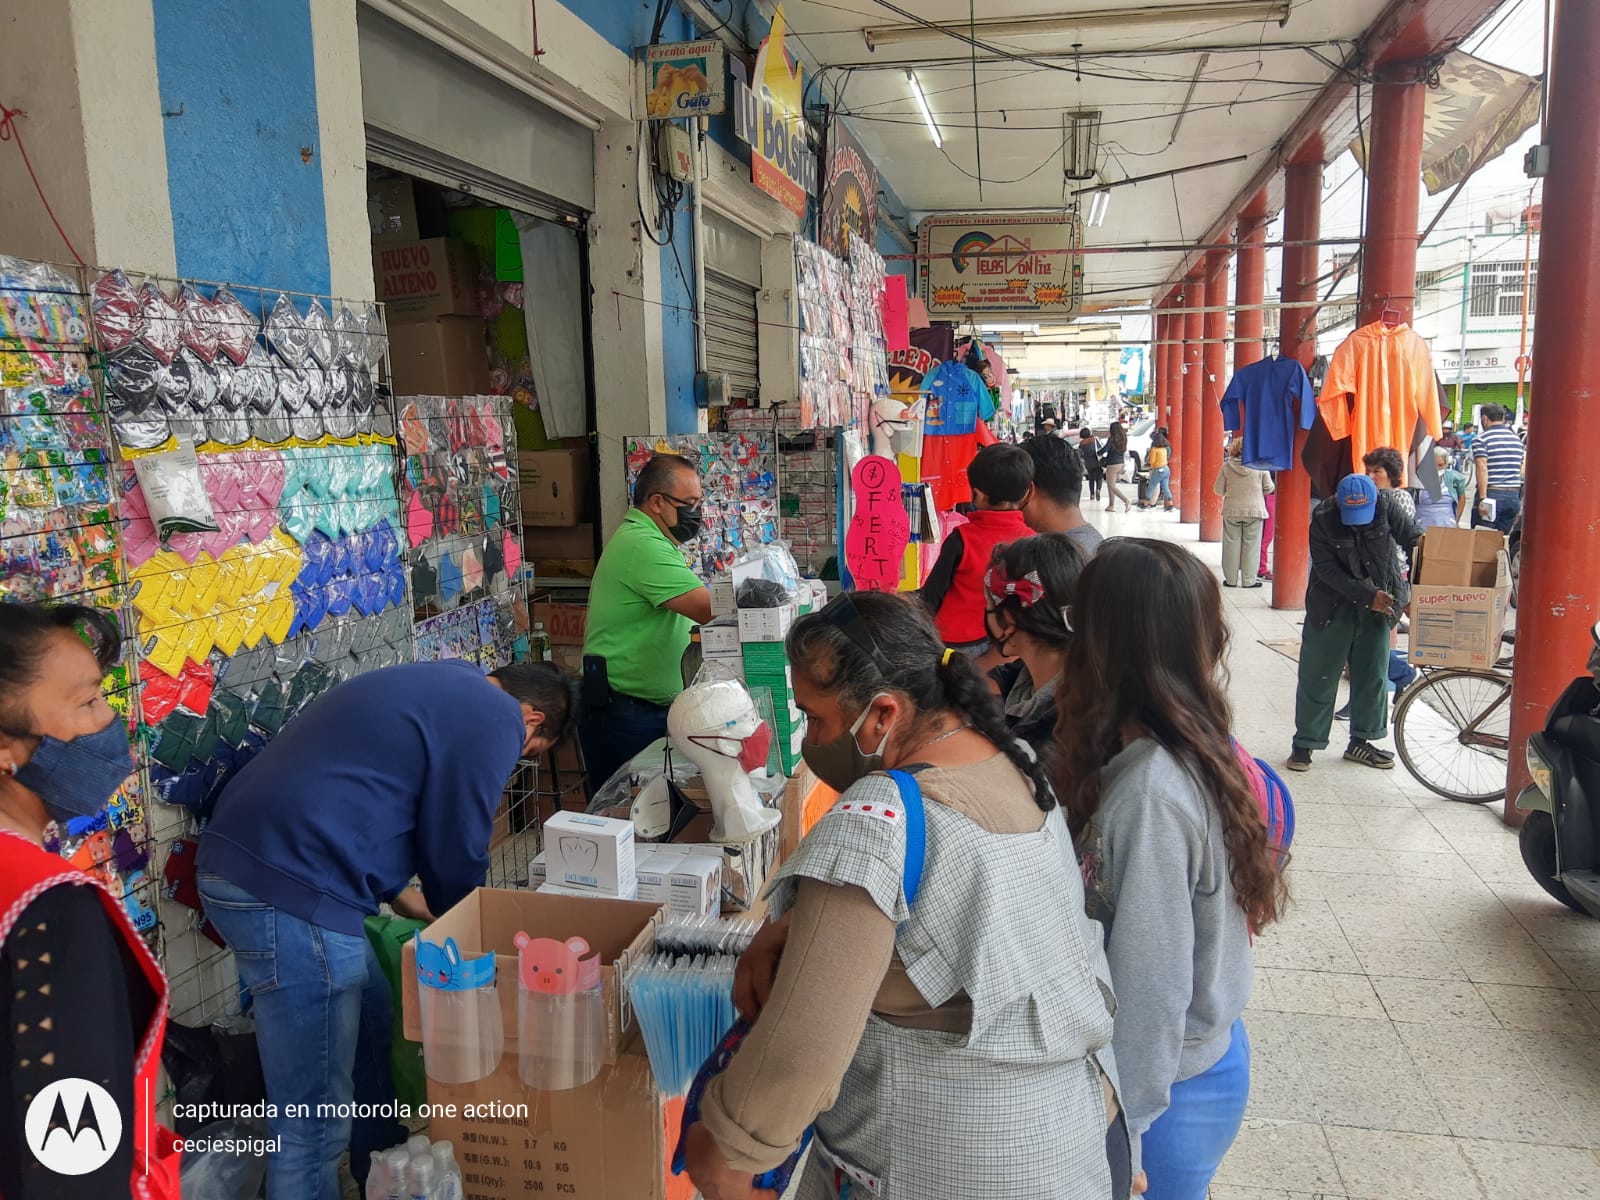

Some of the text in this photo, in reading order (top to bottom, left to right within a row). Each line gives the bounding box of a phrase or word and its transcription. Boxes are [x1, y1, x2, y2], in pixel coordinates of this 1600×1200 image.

[729, 53, 758, 150] Tu
[381, 245, 430, 272] HUEVO
[1485, 356, 1499, 367] 3B
[1418, 594, 1449, 606] super
[1452, 592, 1488, 603] huevo
[133, 911, 153, 927] N95
[553, 1141, 568, 1152] KG
[556, 1162, 569, 1173] KG
[556, 1183, 576, 1194] PCS
